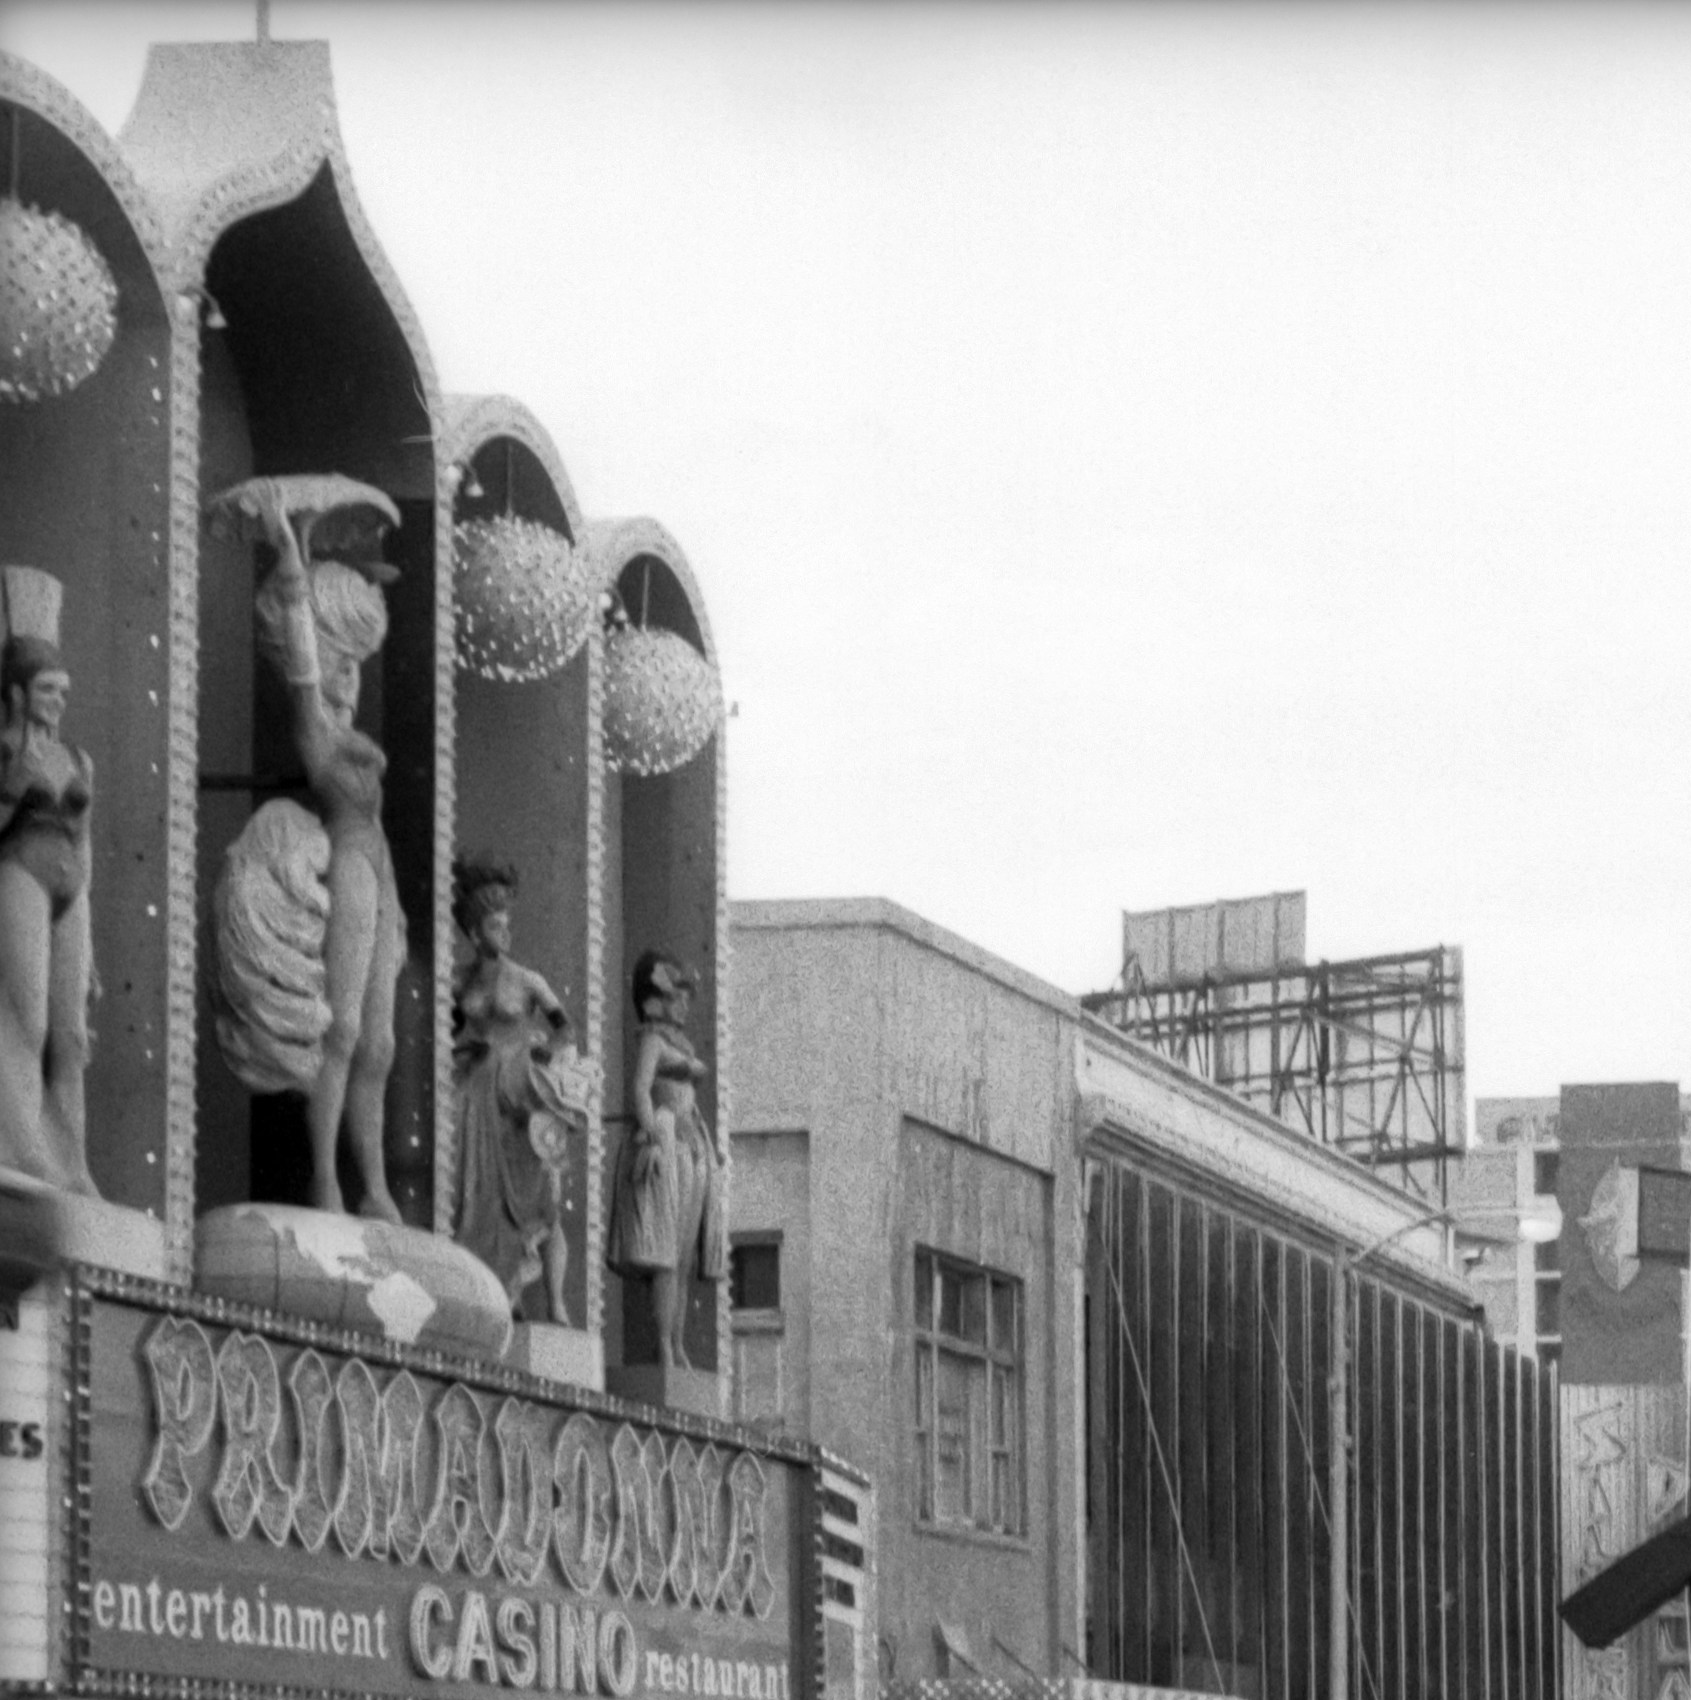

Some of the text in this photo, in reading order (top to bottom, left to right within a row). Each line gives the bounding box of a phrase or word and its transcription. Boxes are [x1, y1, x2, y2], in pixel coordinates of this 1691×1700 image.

[143, 1316, 777, 1621] PRIMADONNA
[94, 1575, 390, 1660] entertainment
[409, 1582, 638, 1697] CASINO
